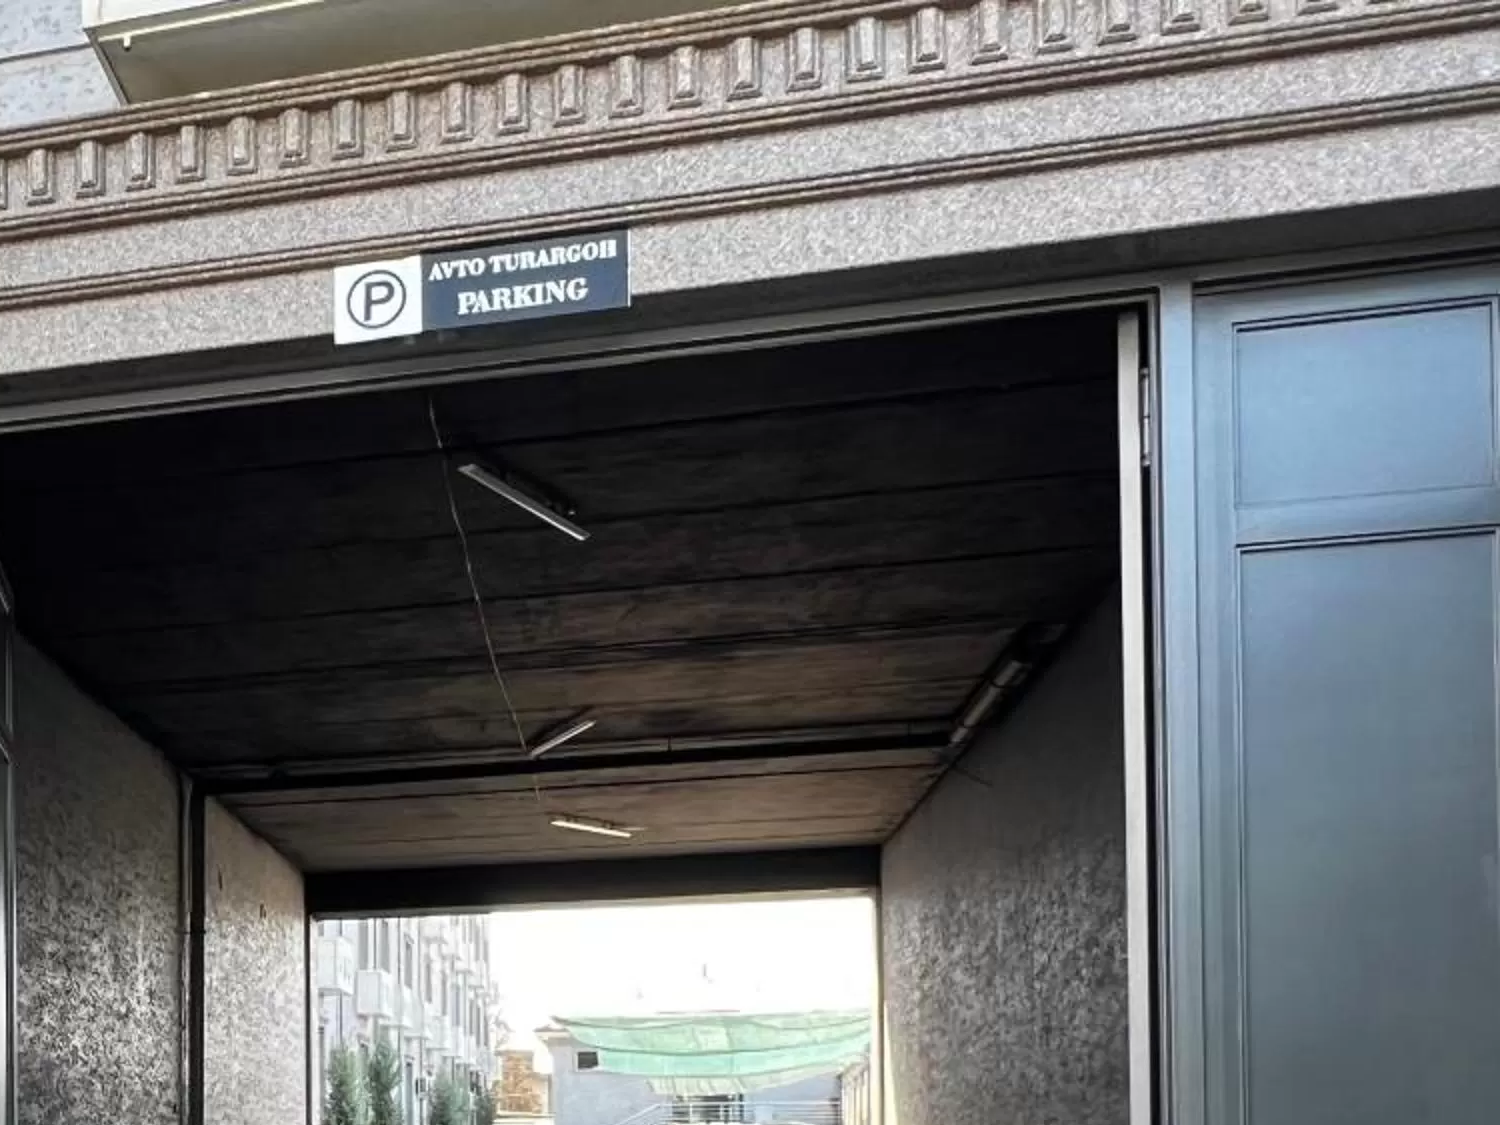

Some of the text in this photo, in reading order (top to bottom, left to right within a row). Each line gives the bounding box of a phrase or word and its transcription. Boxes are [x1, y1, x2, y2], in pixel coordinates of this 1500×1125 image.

[428, 239, 617, 281] AVTO TURARGOH
[363, 281, 395, 322] P
[457, 277, 589, 316] PARKING
